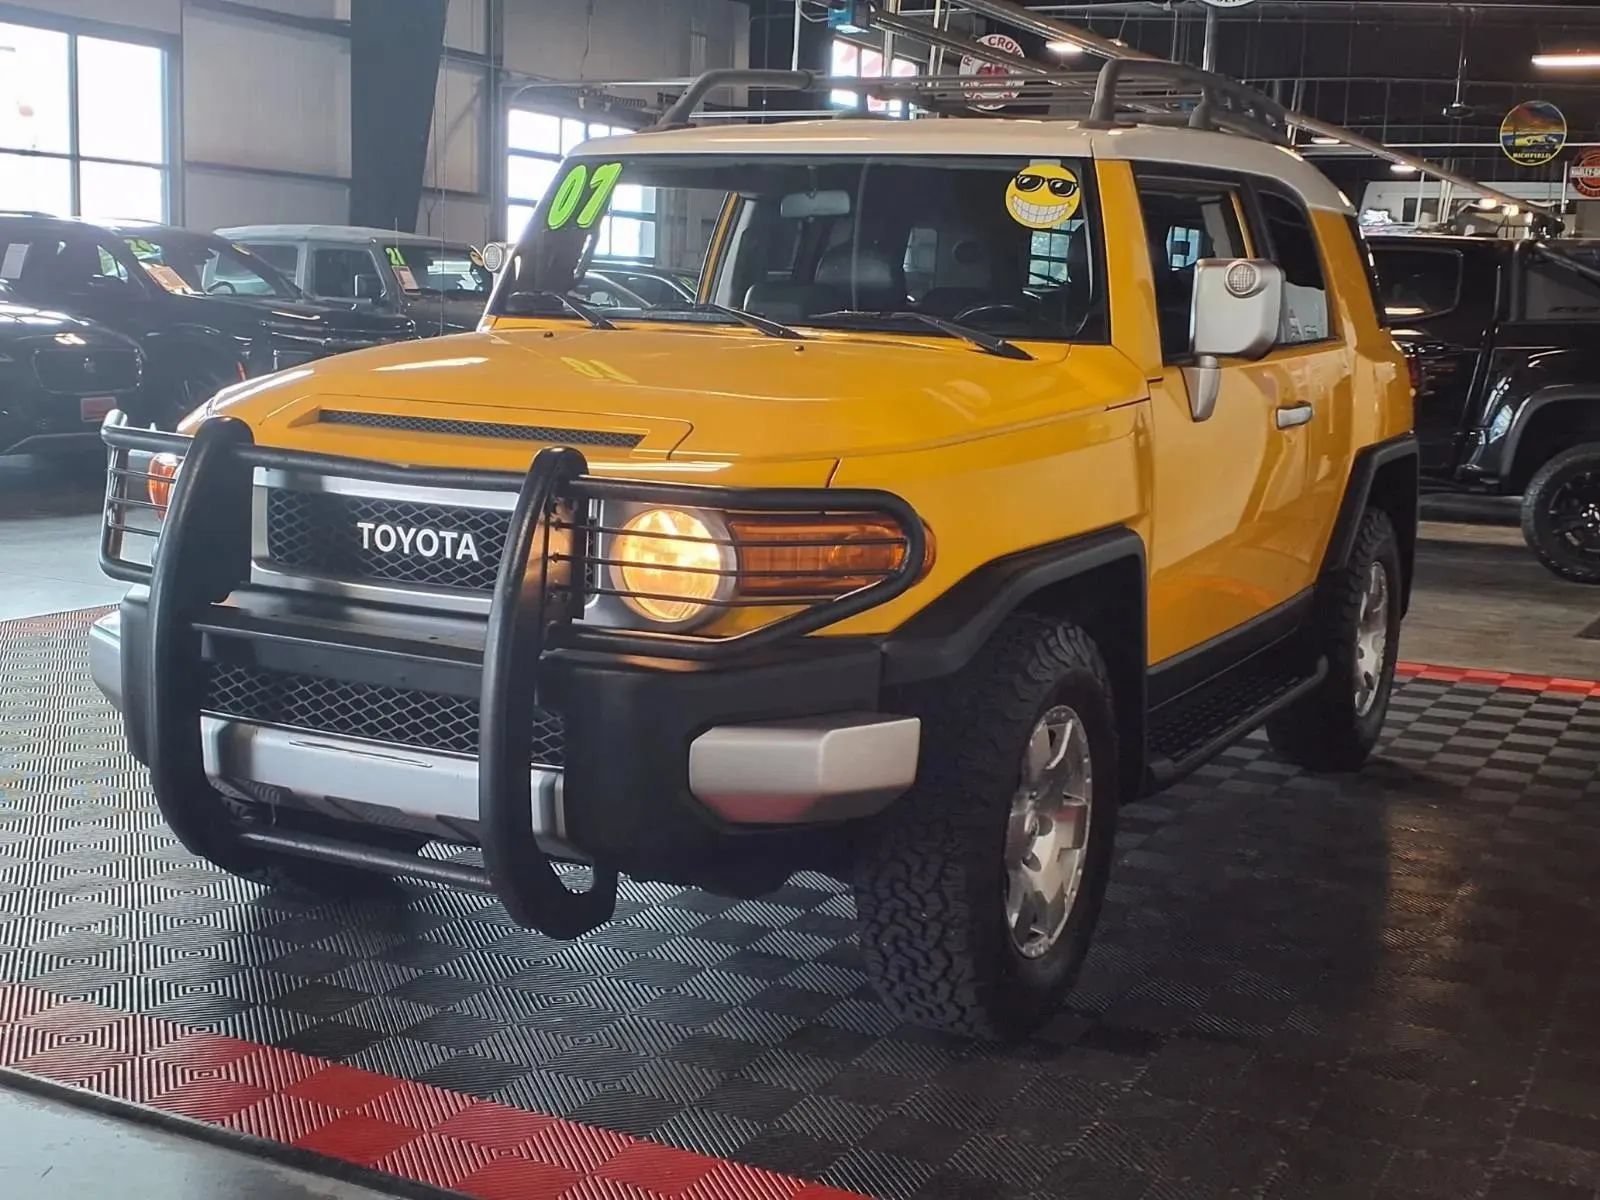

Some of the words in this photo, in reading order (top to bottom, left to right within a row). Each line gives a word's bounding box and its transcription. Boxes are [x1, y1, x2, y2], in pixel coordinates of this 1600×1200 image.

[547, 163, 623, 230] 07
[385, 247, 406, 265] 21
[357, 522, 479, 562] TOYOTA
